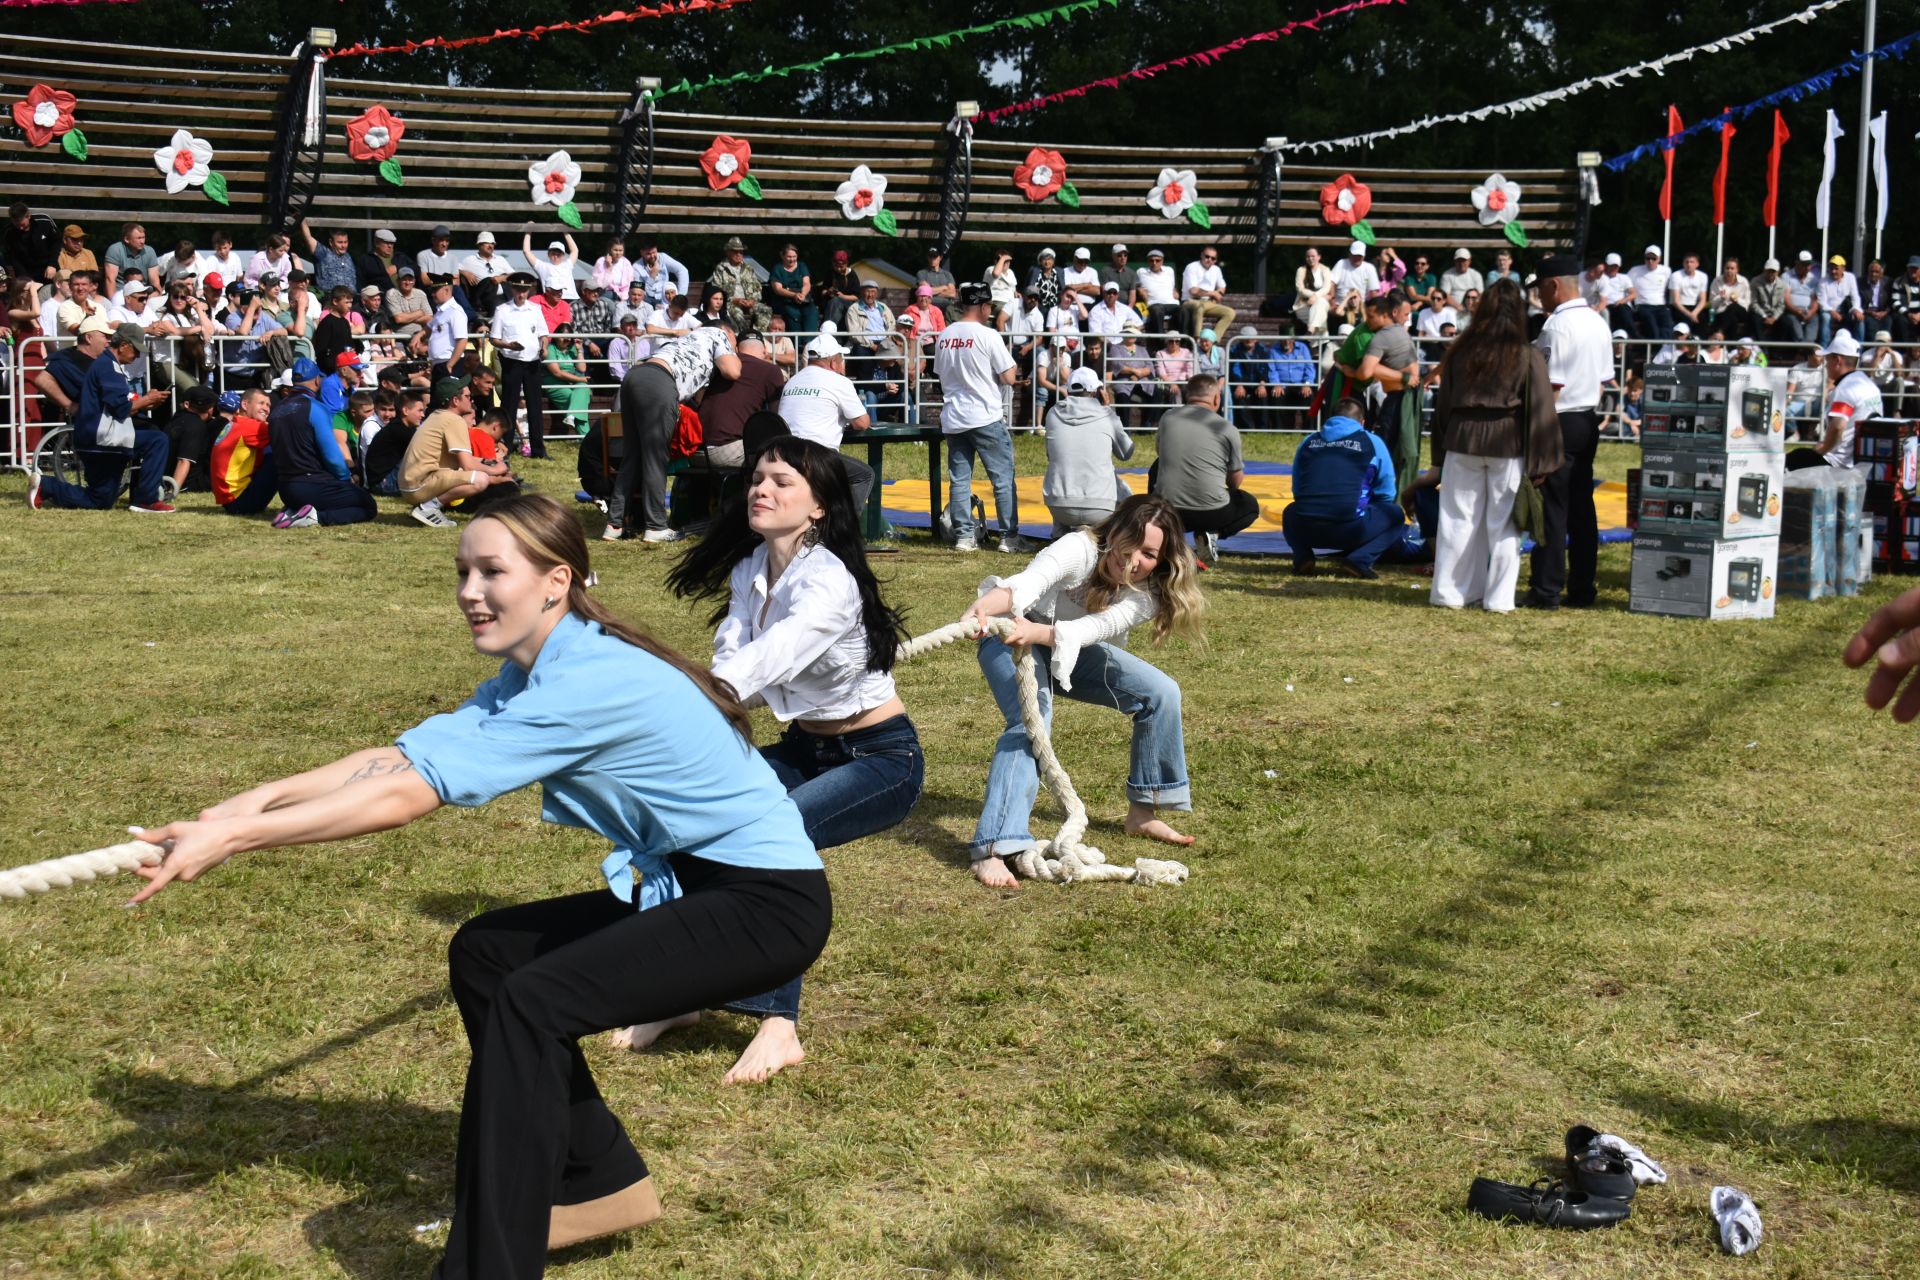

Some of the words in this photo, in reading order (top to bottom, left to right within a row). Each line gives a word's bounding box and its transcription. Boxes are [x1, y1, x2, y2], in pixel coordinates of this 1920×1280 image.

[939, 338, 974, 350] СУДЬЯ
[1646, 369, 1675, 378] gorenje
[1644, 454, 1673, 463] gorenje
[1633, 538, 1662, 547] gorenje
[1717, 543, 1738, 553] gorenje
